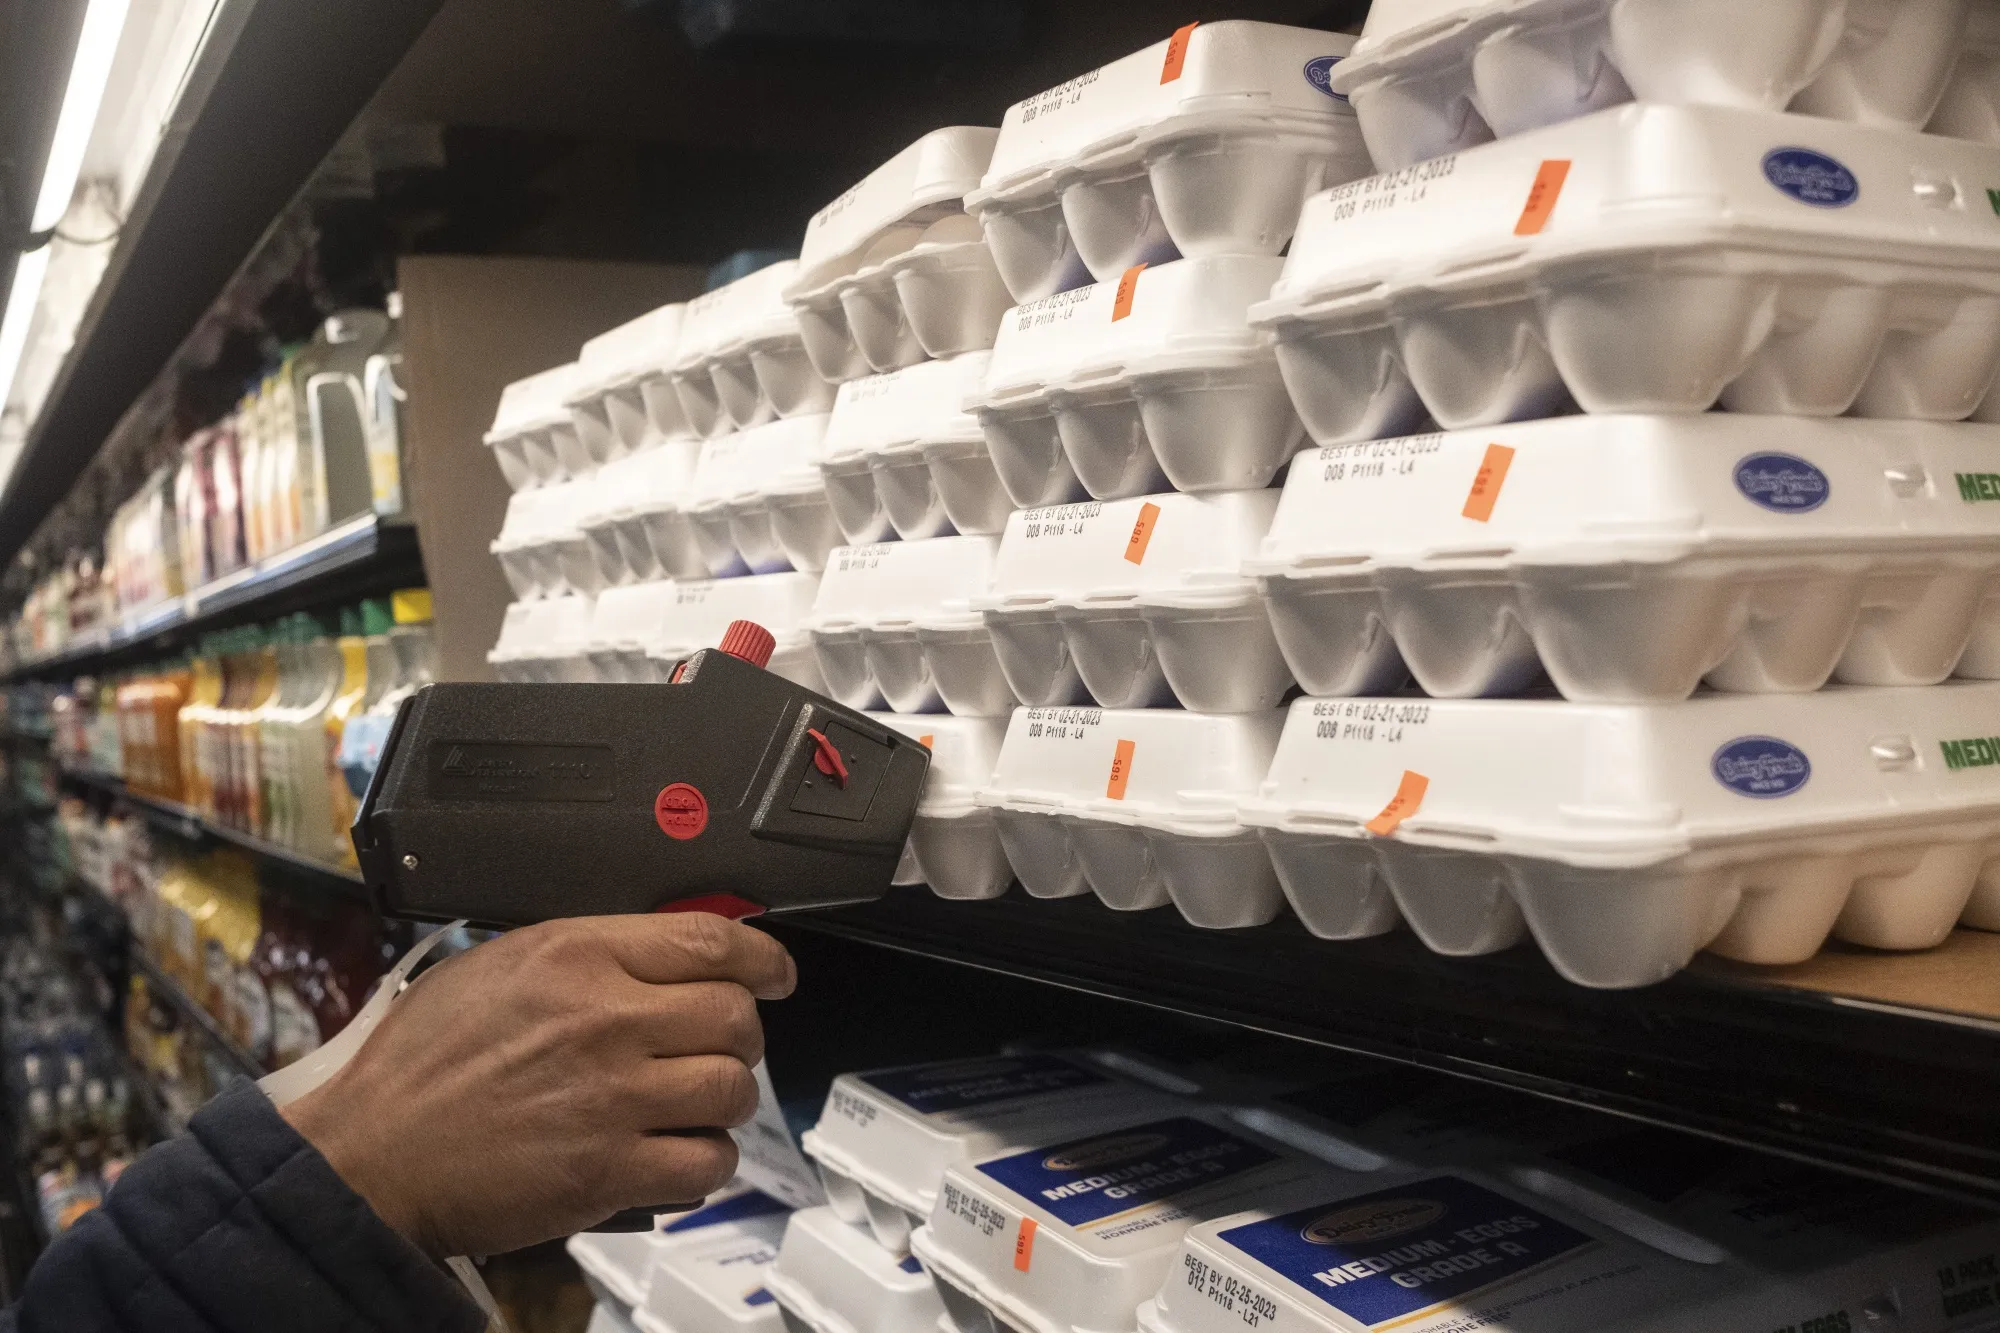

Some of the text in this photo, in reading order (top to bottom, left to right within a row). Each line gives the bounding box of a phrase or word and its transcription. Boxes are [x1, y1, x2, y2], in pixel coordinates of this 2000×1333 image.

[1022, 106, 1038, 124] 008
[1040, 98, 1062, 116] P1118
[1329, 182, 1362, 203] BEST
[1383, 155, 1457, 192] 02-21-2023
[1334, 201, 1356, 222] 008
[1361, 194, 1396, 214] P1118
[1018, 315, 1032, 332] 008
[1034, 311, 1056, 327] P1118
[1319, 447, 1351, 461] BEST
[1372, 434, 1445, 458] 02-21-2023
[1323, 463, 1346, 482] 008
[1351, 461, 1385, 478] P1118
[1056, 503, 1102, 521] 02-21-2023
[1026, 524, 1041, 538] 008
[1043, 523, 1065, 537] P1118
[1130, 520, 1145, 544] 599
[1027, 707, 1048, 720] BEST
[1058, 710, 1103, 726] 02-21-2023
[1313, 702, 1431, 725] BEST BY 02-21-2023
[1029, 723, 1043, 738] 008
[1045, 725, 1067, 739] P1118
[1316, 720, 1339, 739] 008
[1343, 723, 1375, 741] P1118
[1110, 758, 1122, 782] 599
[1041, 1160, 1161, 1201] MEDIUM
[1103, 1166, 1202, 1200] GRADE
[1100, 1220, 1161, 1240] HORMONE
[1016, 1234, 1026, 1255] 599
[1312, 1214, 1541, 1288] MEDIUM EGGS
[1389, 1239, 1532, 1289] GRADE A
[1184, 1253, 1277, 1321] BEST BY 02-25-2023
[1187, 1270, 1205, 1293] 012
[1208, 1286, 1233, 1311] P1118
